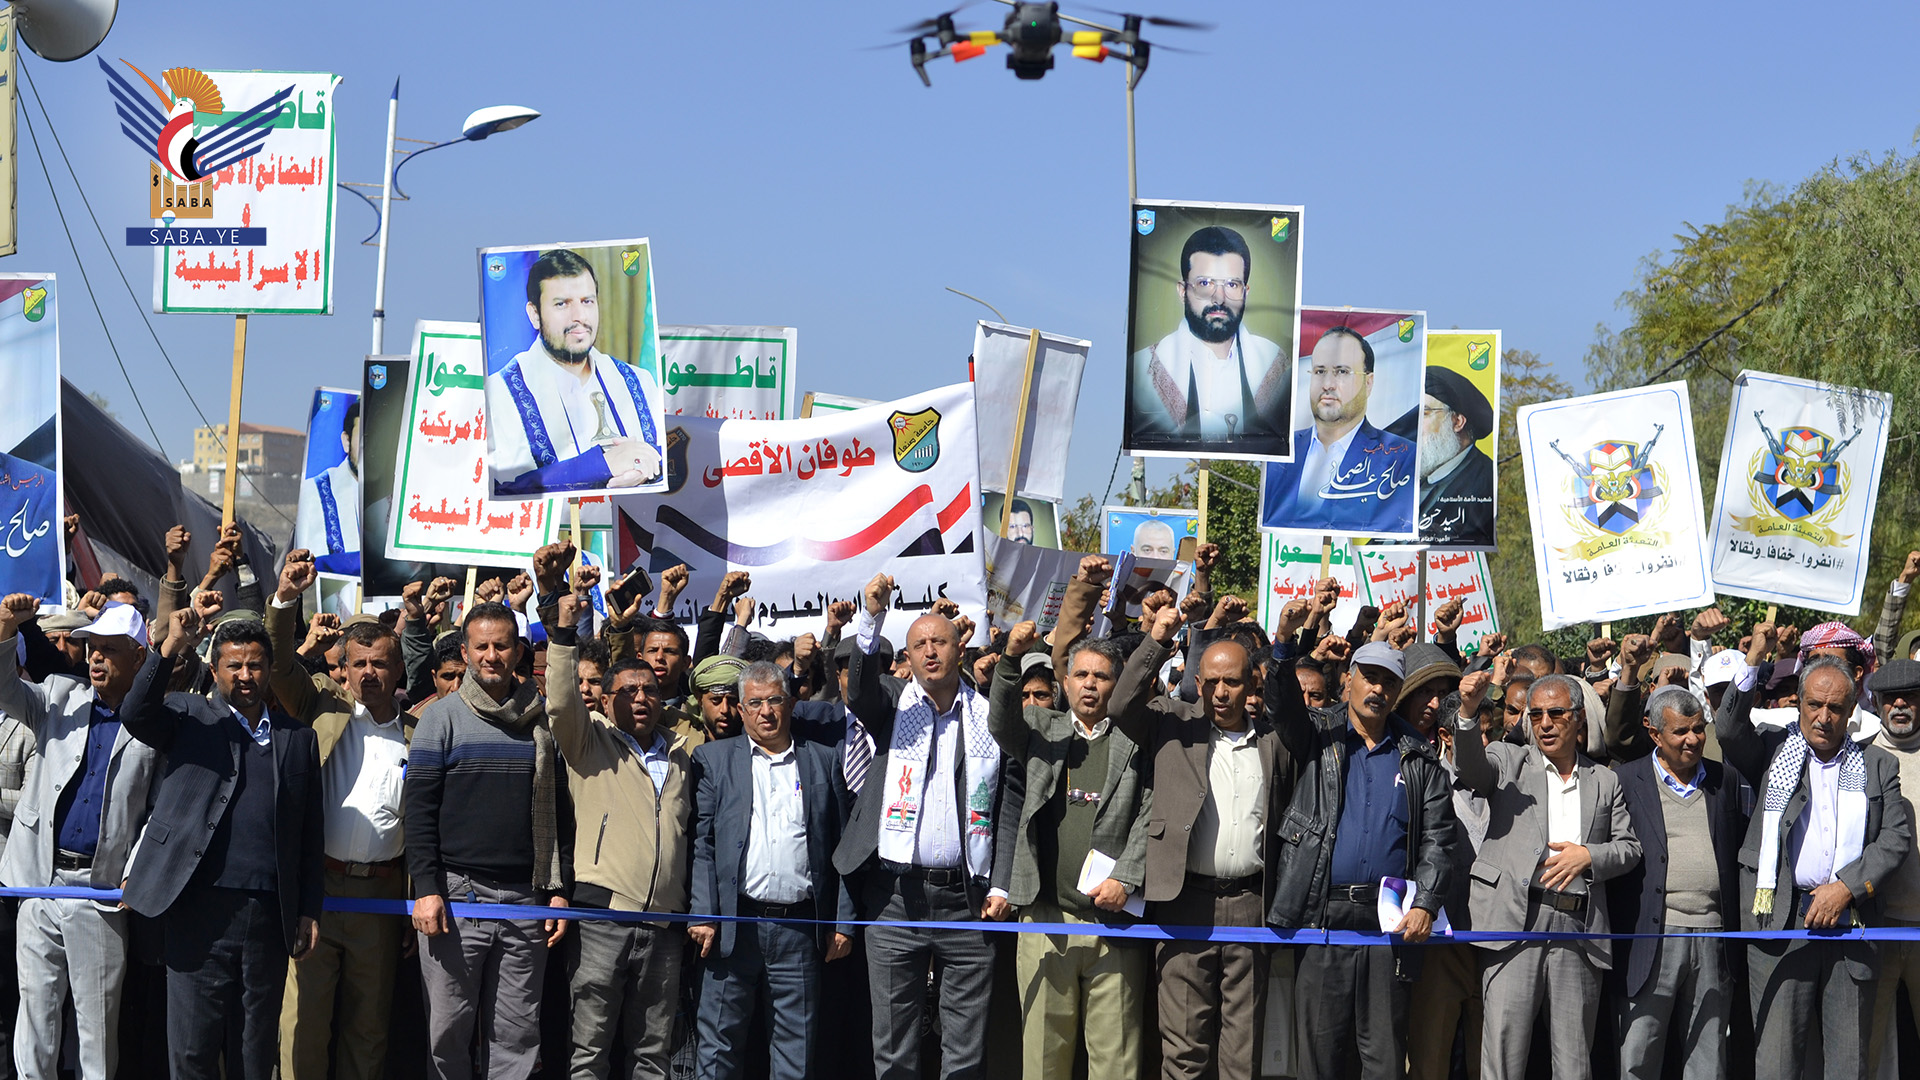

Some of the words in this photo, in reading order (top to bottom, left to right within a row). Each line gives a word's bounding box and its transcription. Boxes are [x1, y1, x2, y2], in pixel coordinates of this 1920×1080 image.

[256, 153, 323, 192] البضائع
[175, 248, 320, 291] الإسرائيلية
[661, 354, 777, 395] قاطعوا
[913, 419, 934, 437] جامعة
[702, 437, 792, 488] الأقصى
[797, 436, 876, 480] طوفان
[897, 437, 917, 456] صنعاء
[473, 457, 483, 484] و
[1377, 460, 1410, 500] صالح
[6, 499, 50, 558] صالح
[408, 494, 544, 536] الإسرائيلية
[1440, 506, 1465, 531] السيد
[1758, 523, 1791, 533] العامة
[1586, 538, 1621, 557] العامة
[1793, 524, 1824, 543] التعبئة
[1436, 574, 1482, 600] الموت
